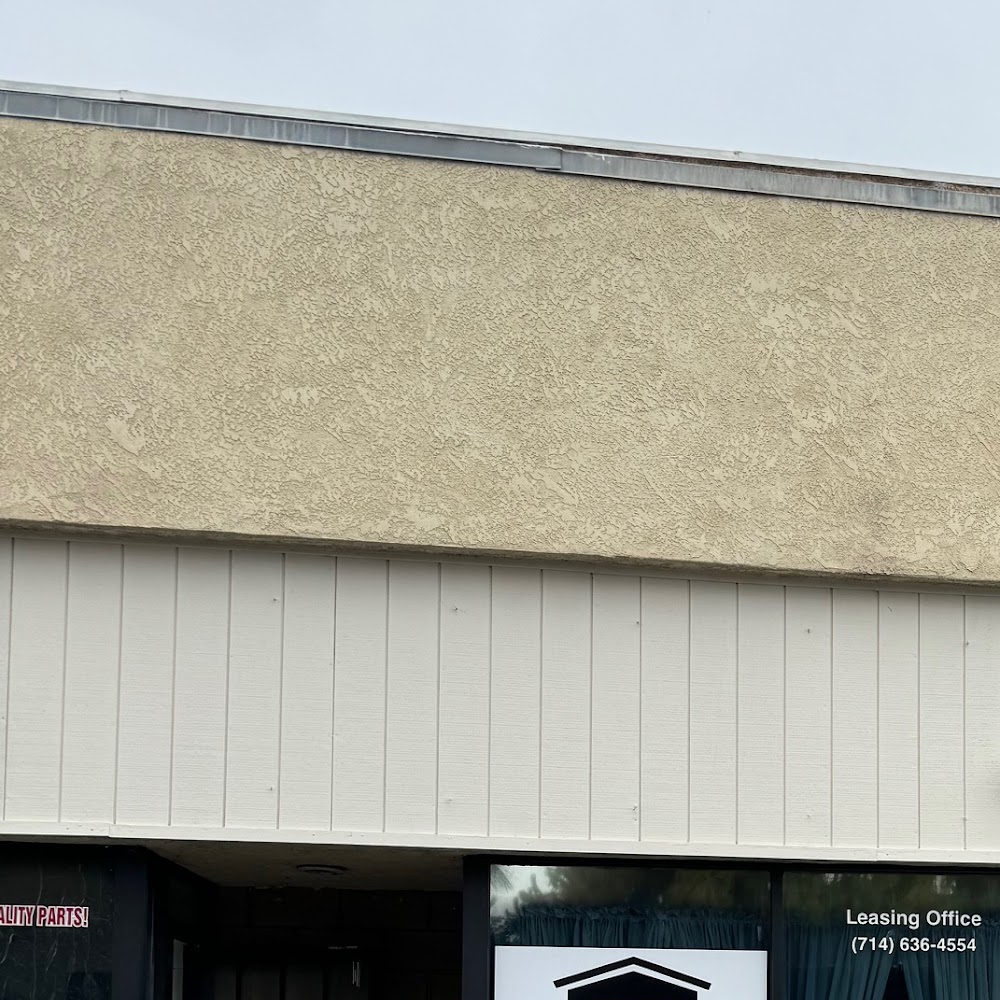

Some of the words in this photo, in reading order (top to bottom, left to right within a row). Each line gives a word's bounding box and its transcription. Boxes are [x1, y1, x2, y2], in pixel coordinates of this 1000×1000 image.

[37, 906, 89, 927] PARTS!
[846, 909, 920, 930] Leasing
[926, 910, 982, 927] Office
[851, 937, 895, 955] (714)
[899, 937, 977, 952] 636-4554
